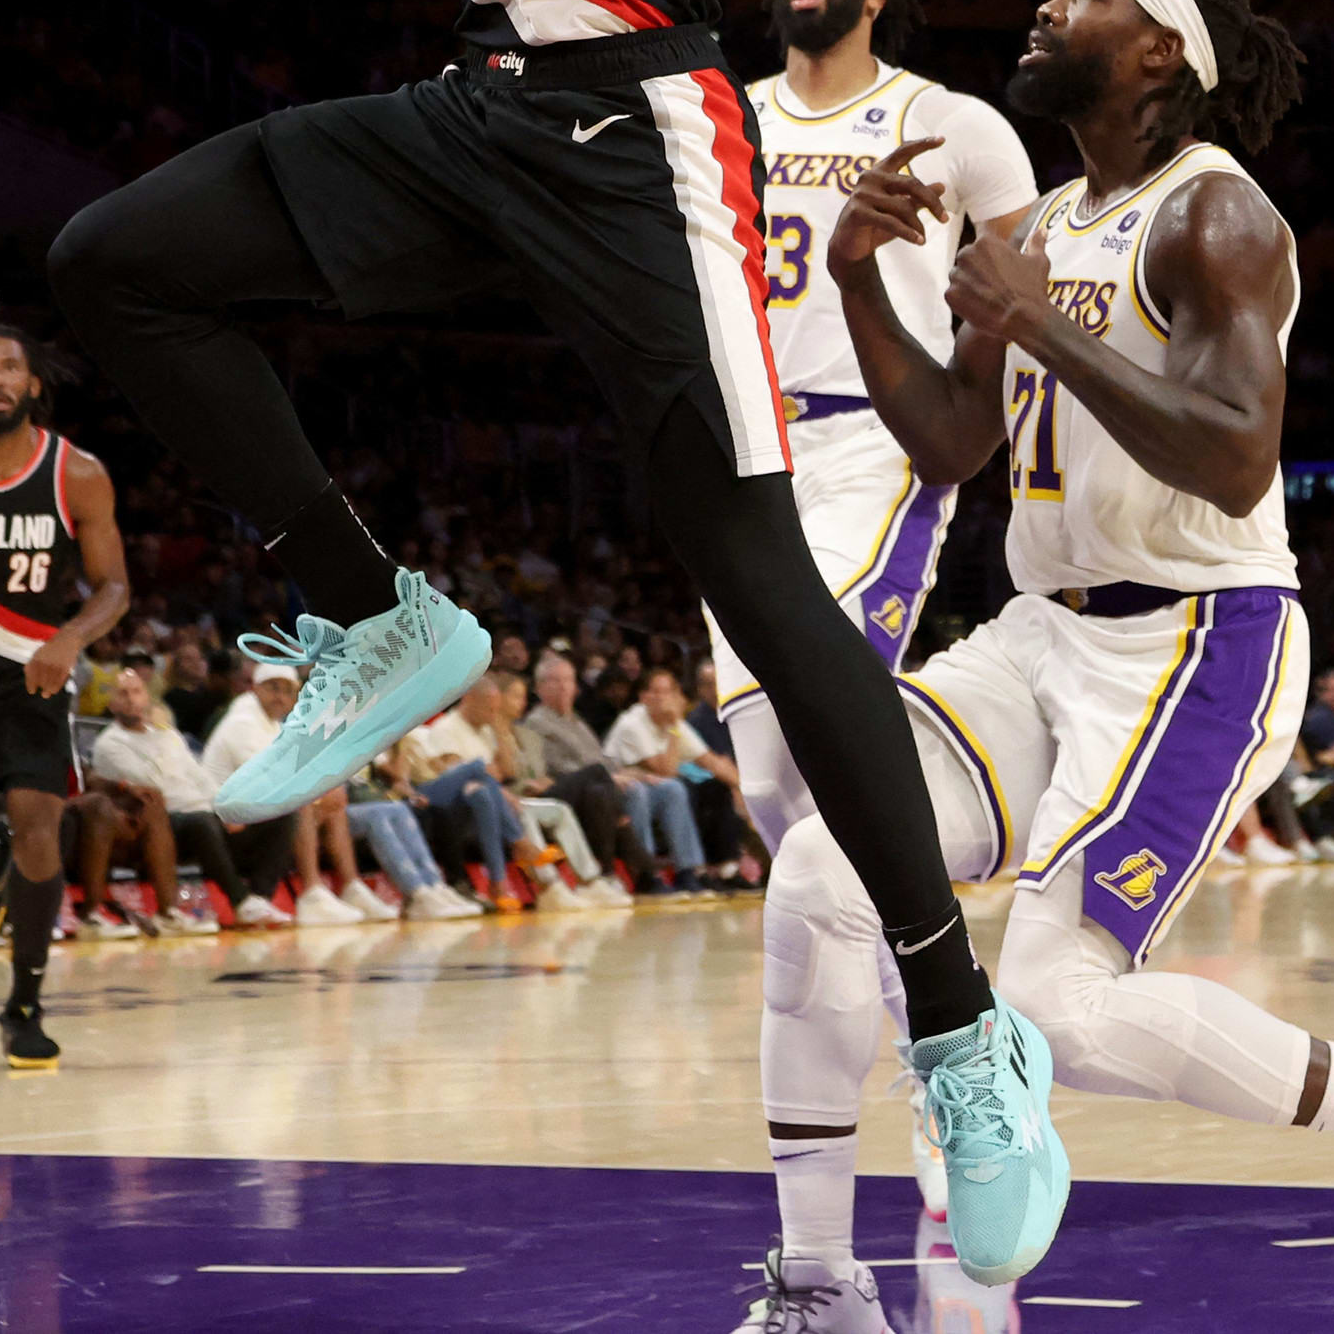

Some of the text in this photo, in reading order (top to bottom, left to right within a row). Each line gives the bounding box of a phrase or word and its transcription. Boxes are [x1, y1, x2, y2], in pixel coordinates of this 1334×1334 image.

[768, 213, 813, 309] 3
[1101, 233, 1133, 256] bibigo
[8, 553, 51, 594] 26
